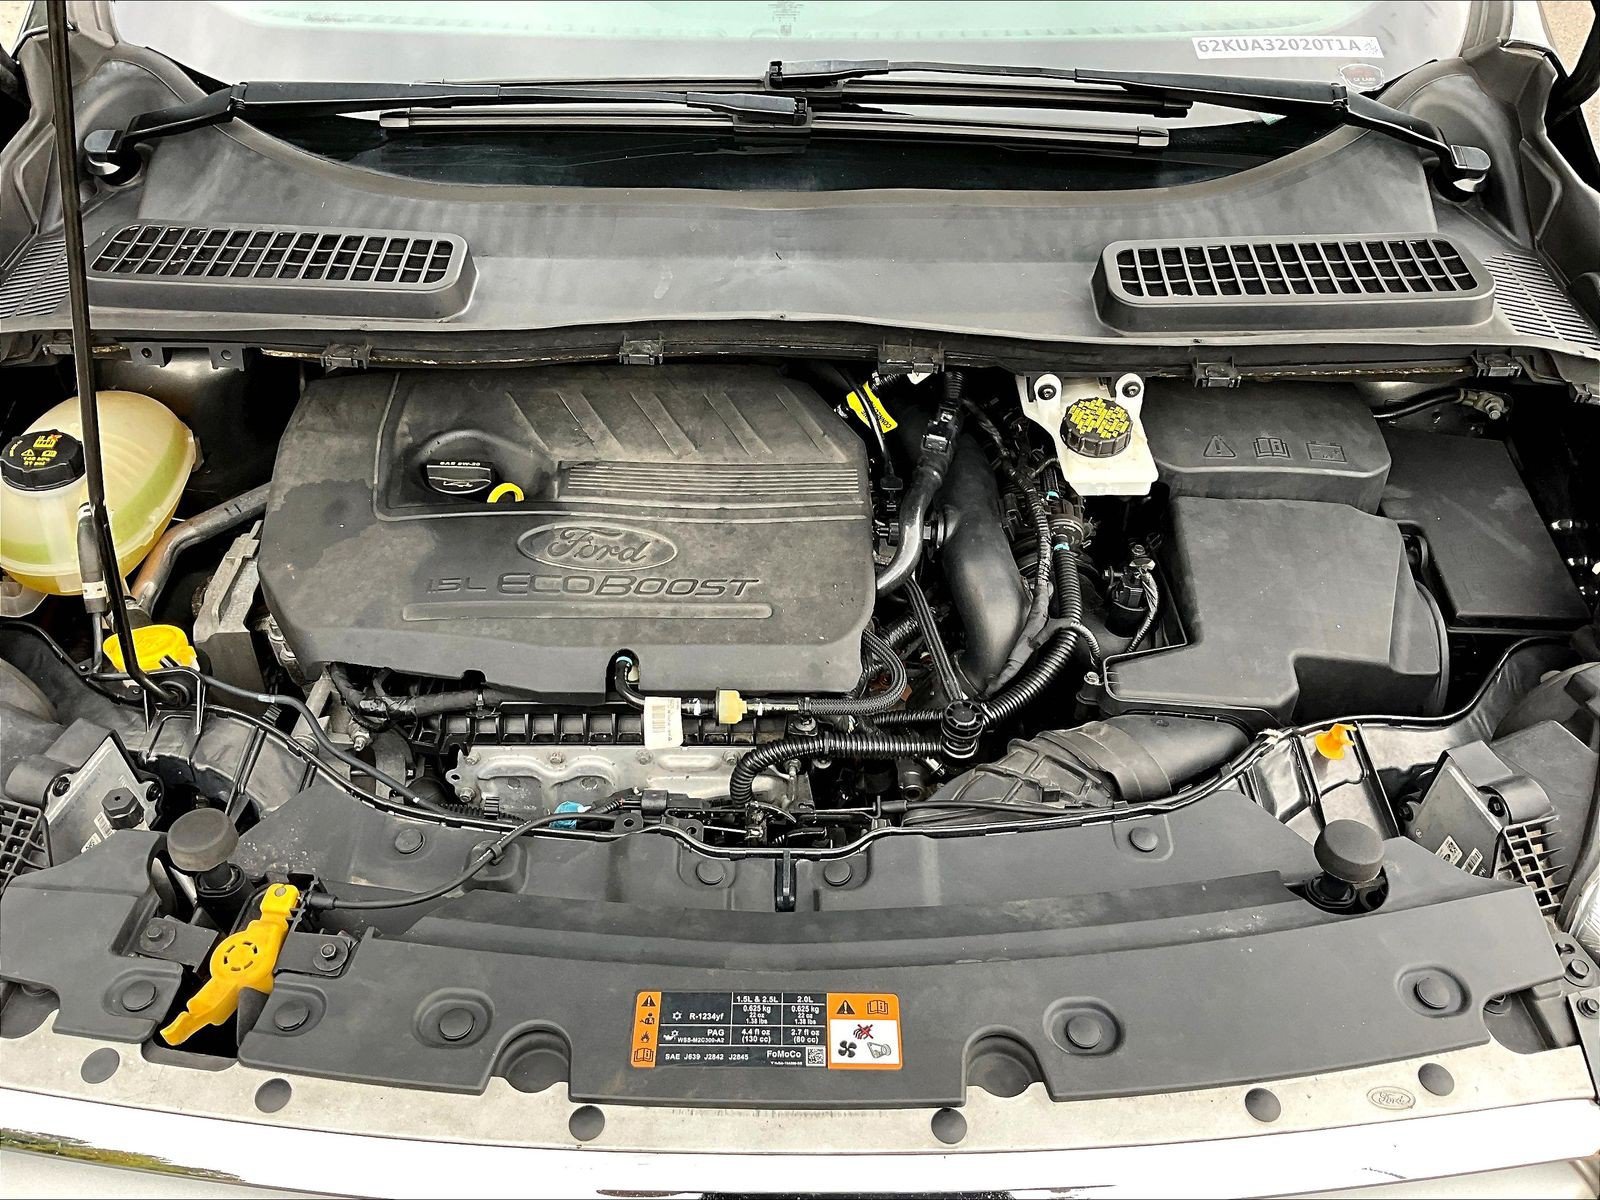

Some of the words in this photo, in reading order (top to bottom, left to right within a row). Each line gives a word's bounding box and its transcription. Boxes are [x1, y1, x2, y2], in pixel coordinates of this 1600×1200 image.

[1197, 38, 1361, 53] 62KUA32020T1A
[548, 526, 652, 566] Ford
[736, 995, 753, 1003] 1.5L
[754, 995, 761, 1003] &
[762, 995, 779, 1003] 2.5L
[743, 1004, 761, 1012] 0.625
[762, 1004, 771, 1013] kg
[811, 1005, 820, 1014] kg
[689, 1012, 725, 1021] R-1234yf
[806, 1036, 819, 1044] cc)
[766, 1049, 802, 1058] FoMoCo
